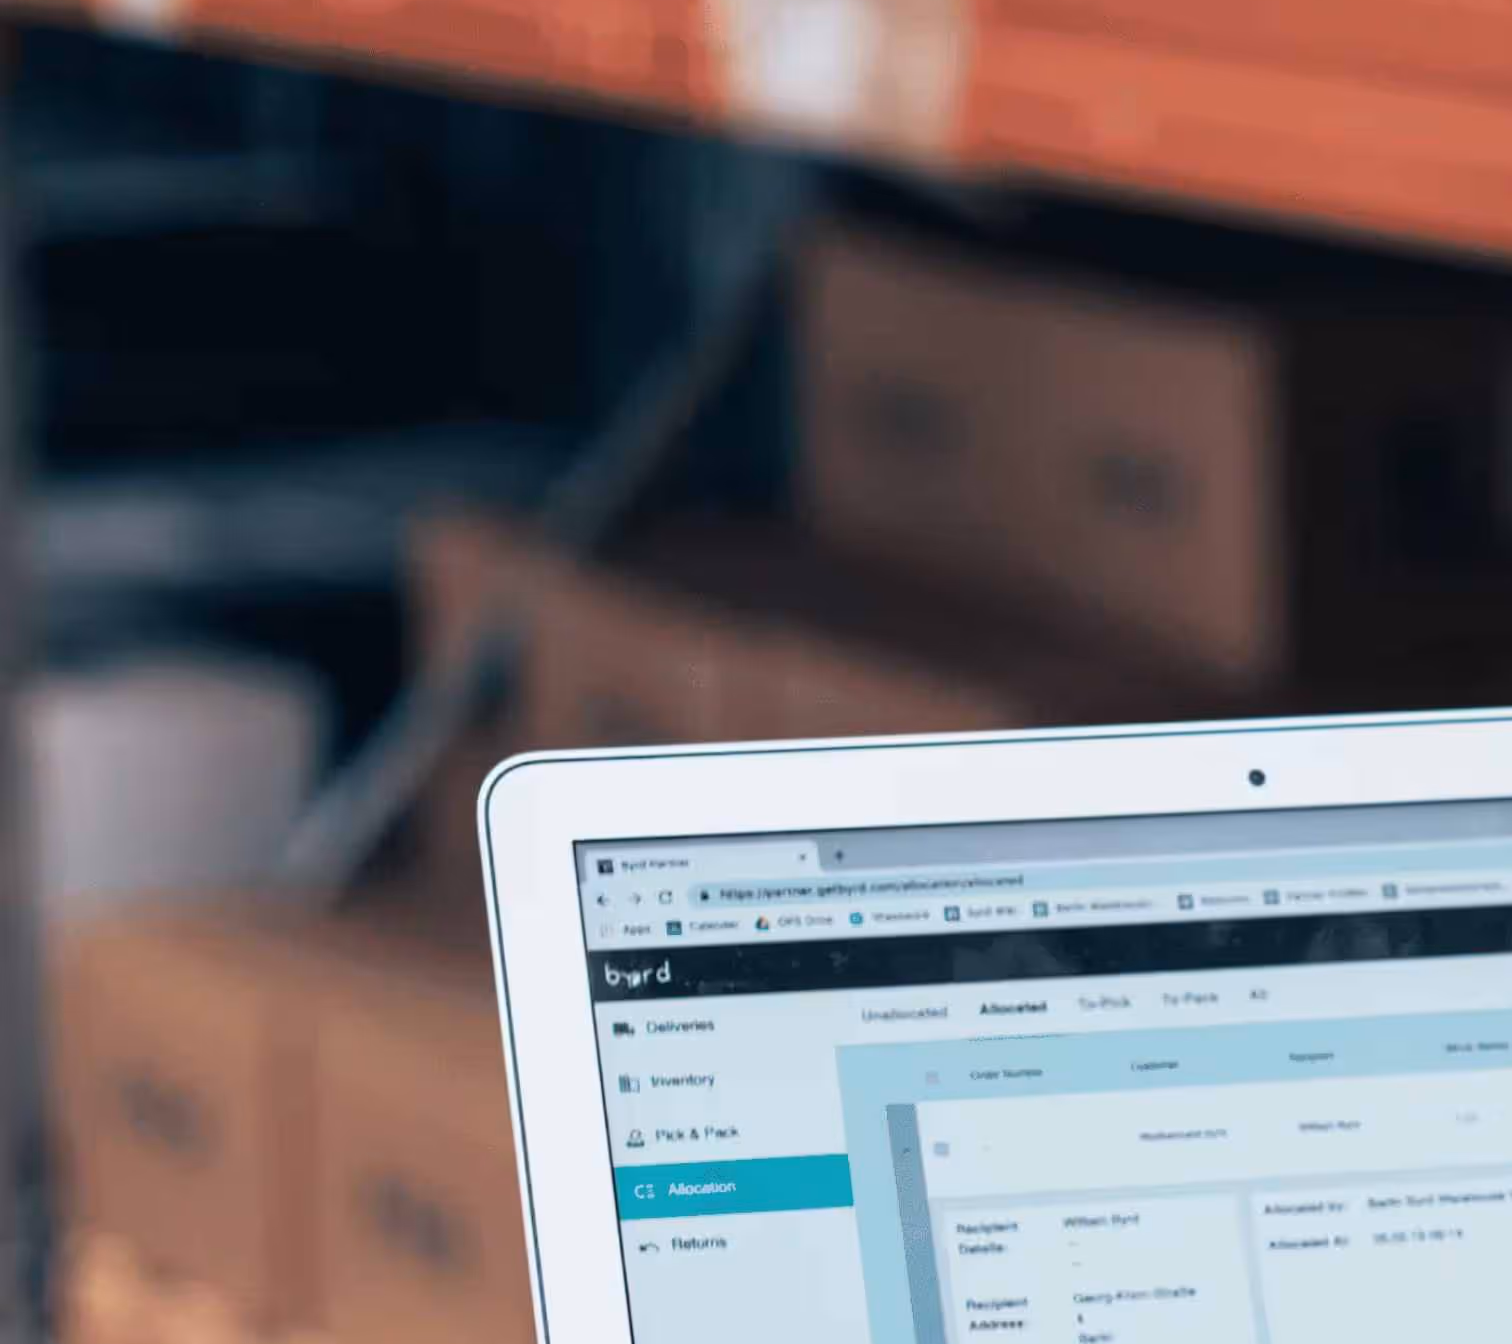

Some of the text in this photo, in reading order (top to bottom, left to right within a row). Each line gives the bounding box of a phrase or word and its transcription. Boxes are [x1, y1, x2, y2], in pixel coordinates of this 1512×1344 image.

[604, 959, 671, 988] byrd
[979, 999, 1048, 1015] Allocated
[646, 1020, 715, 1035] Deliveries
[650, 1072, 716, 1089] Inventory
[655, 1125, 740, 1142] Pick & Pack
[668, 1180, 737, 1197] Allocation
[672, 1235, 727, 1251] Returns
